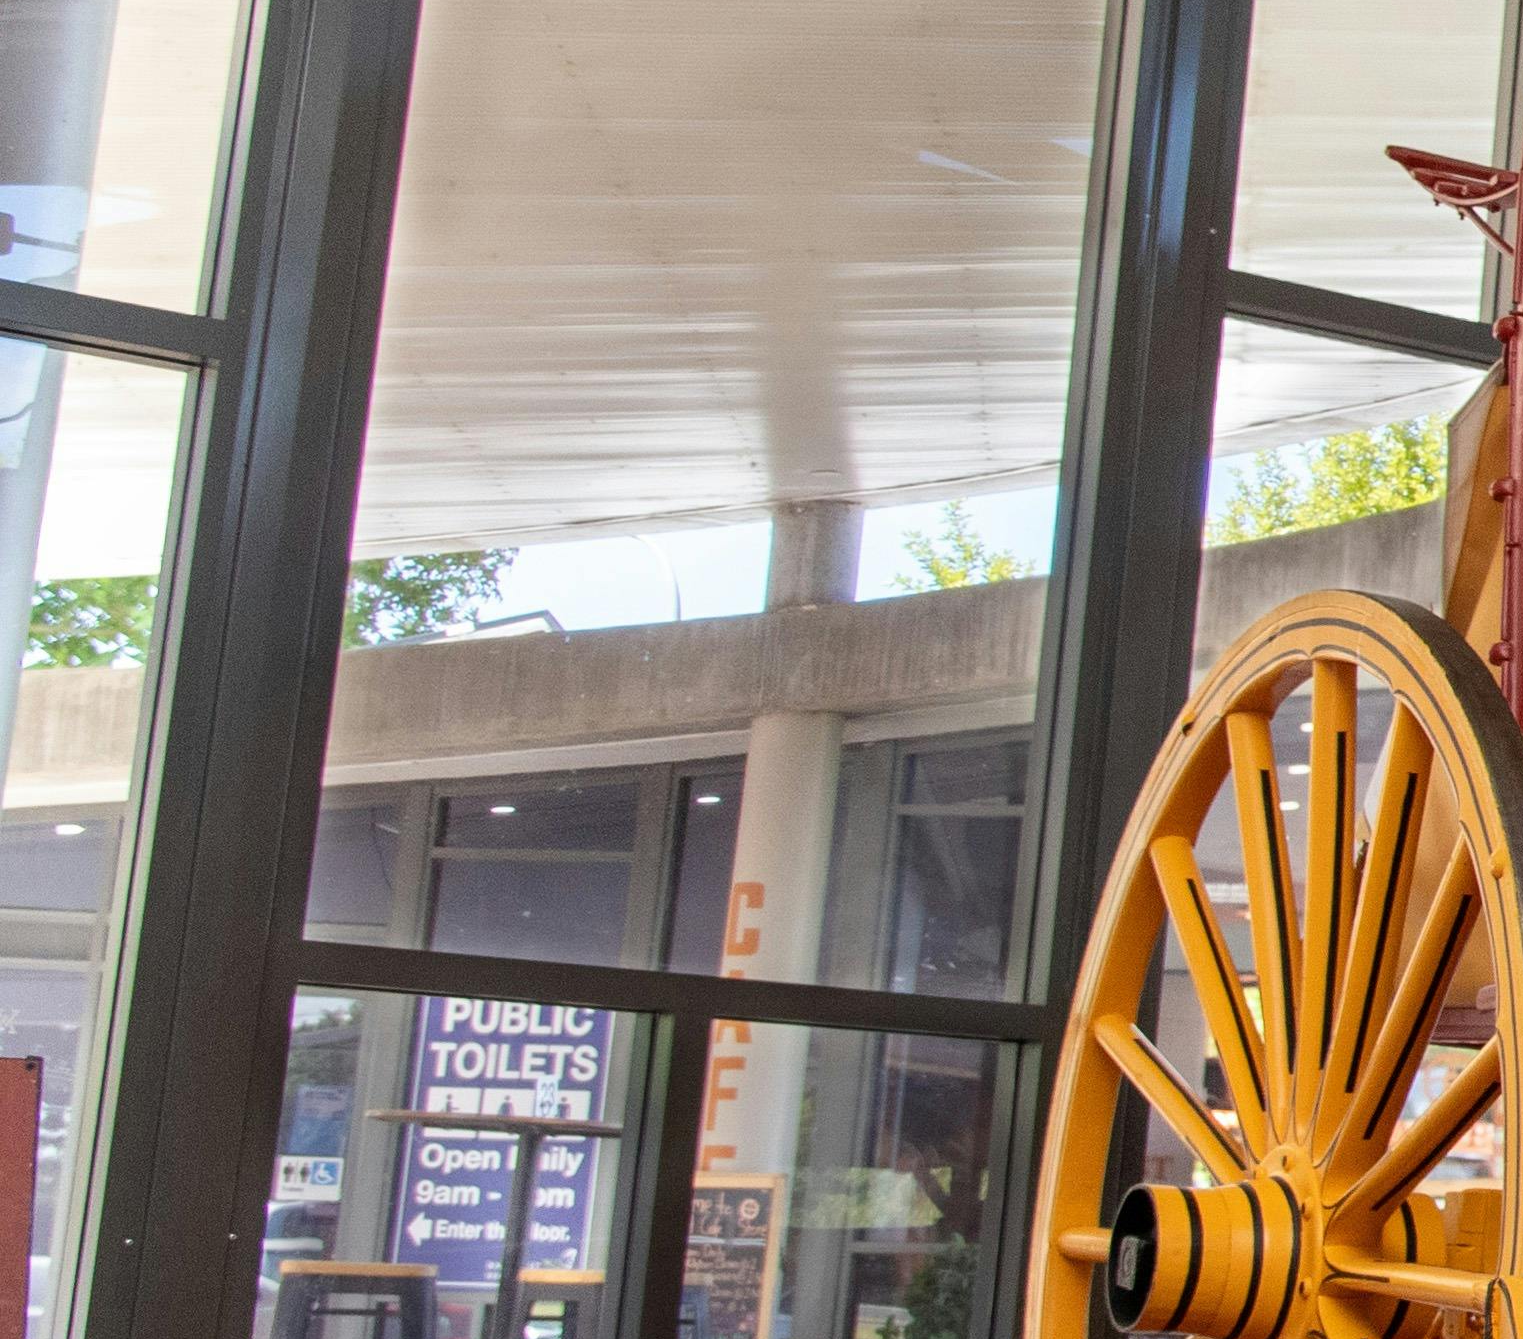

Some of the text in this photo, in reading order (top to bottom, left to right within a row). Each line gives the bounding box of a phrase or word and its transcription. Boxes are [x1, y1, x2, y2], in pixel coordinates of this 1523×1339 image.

[442, 997, 595, 1036] PUBLIC
[427, 1040, 600, 1082] TOILETS
[419, 1142, 501, 1174] Open
[415, 1179, 481, 1207] 9am
[434, 1218, 484, 1241] Enter
[484, 1219, 506, 1241] th
